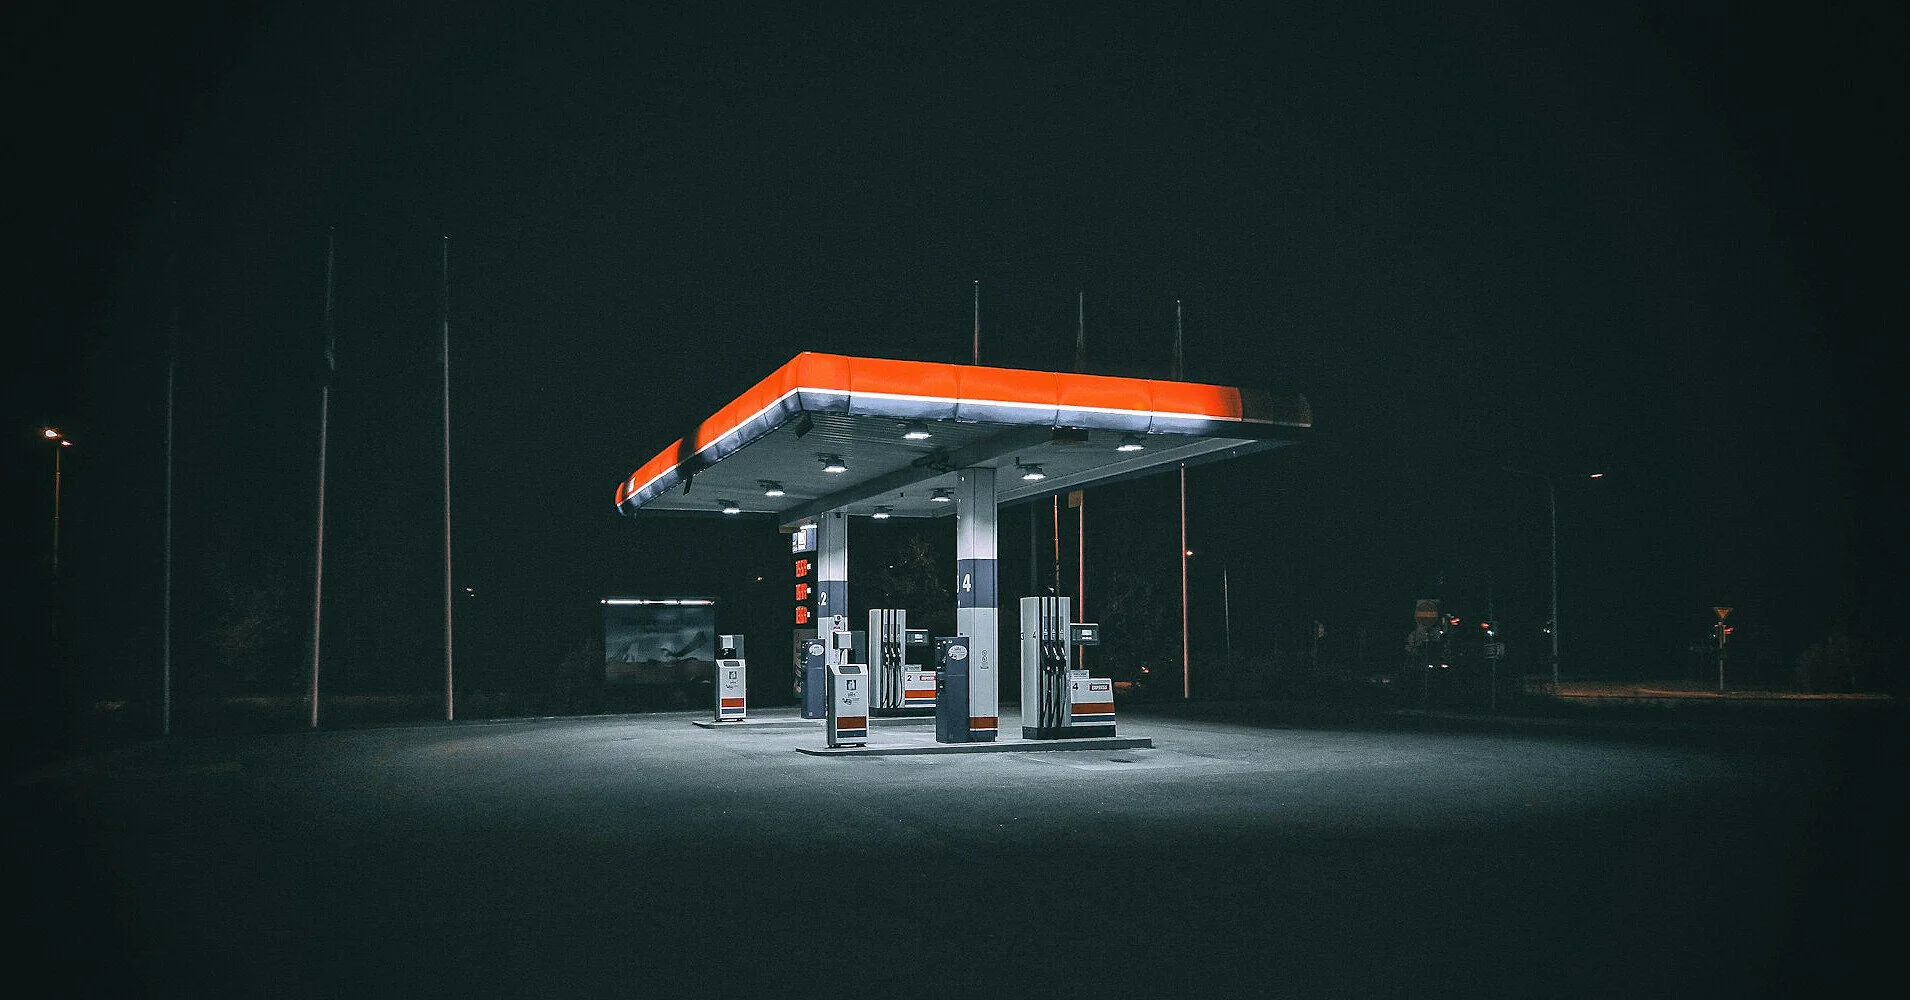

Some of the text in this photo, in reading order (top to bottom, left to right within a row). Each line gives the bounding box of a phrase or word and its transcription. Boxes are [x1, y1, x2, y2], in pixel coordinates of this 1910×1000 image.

[962, 573, 972, 592] 4
[820, 591, 827, 606] 2
[907, 674, 912, 682] 2
[1072, 682, 1079, 691] 4
